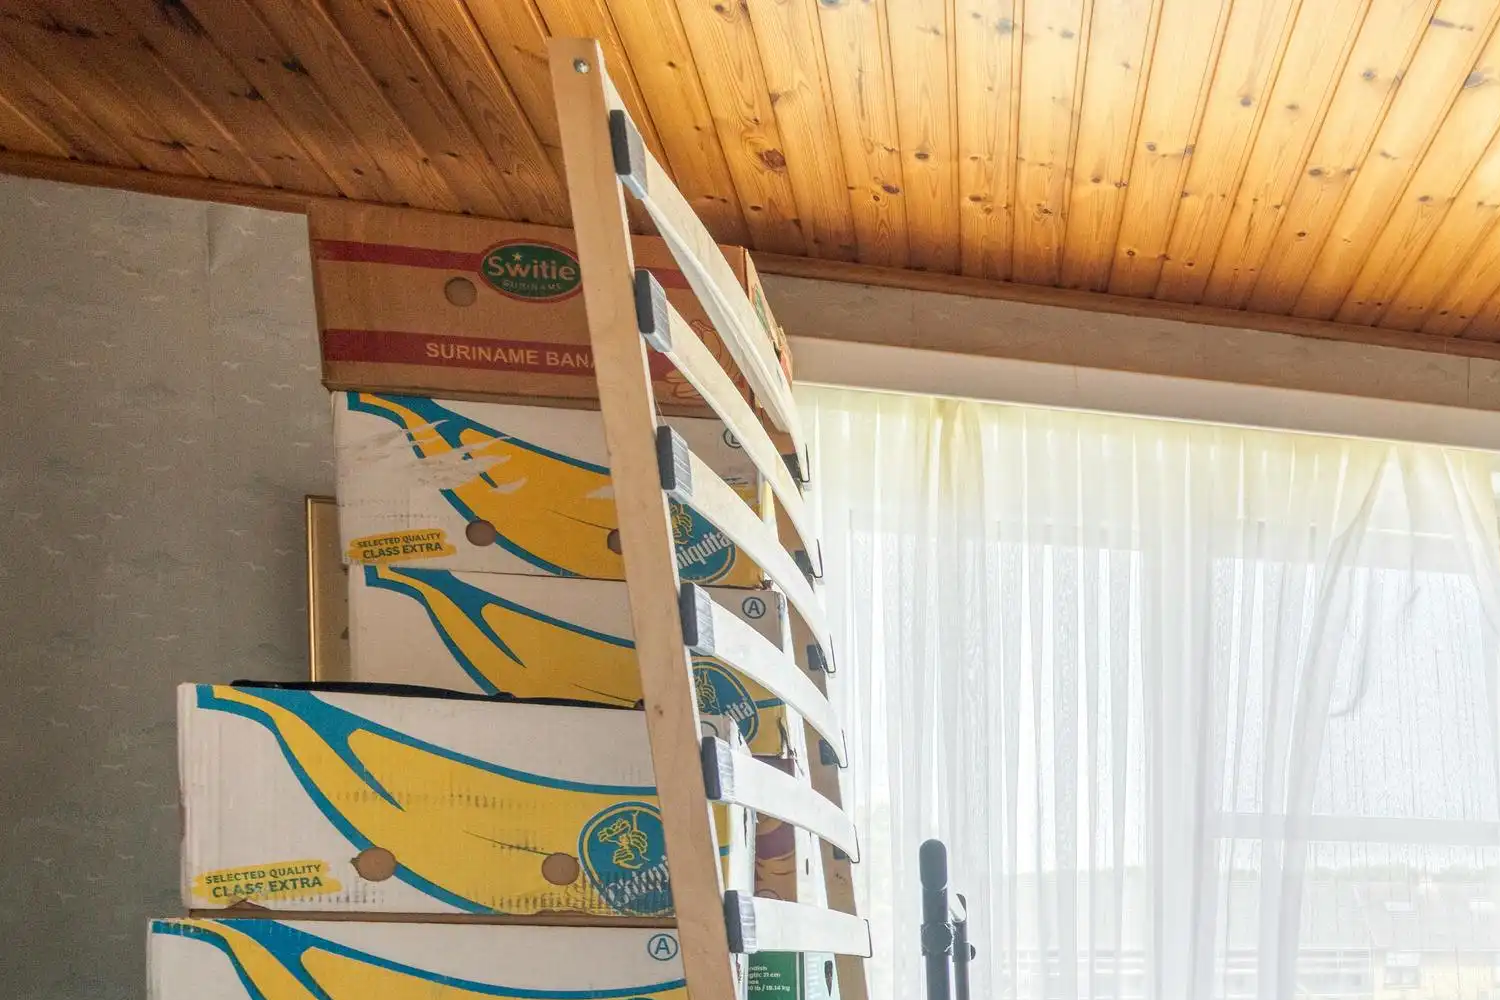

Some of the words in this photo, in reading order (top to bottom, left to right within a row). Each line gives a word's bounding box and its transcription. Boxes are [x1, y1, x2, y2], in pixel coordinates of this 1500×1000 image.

[487, 255, 576, 281] Switie
[426, 342, 539, 366] SURINAME
[358, 537, 400, 549] SELECTED
[402, 531, 441, 544] QUALITY
[363, 546, 400, 559] CLASS
[402, 542, 444, 555] EXTRA
[747, 600, 761, 615] A
[205, 871, 266, 885] SELECTED
[269, 863, 322, 879] QUALITY
[212, 882, 264, 899] CLASS
[268, 876, 323, 893] EXTRA
[654, 937, 671, 955] A
